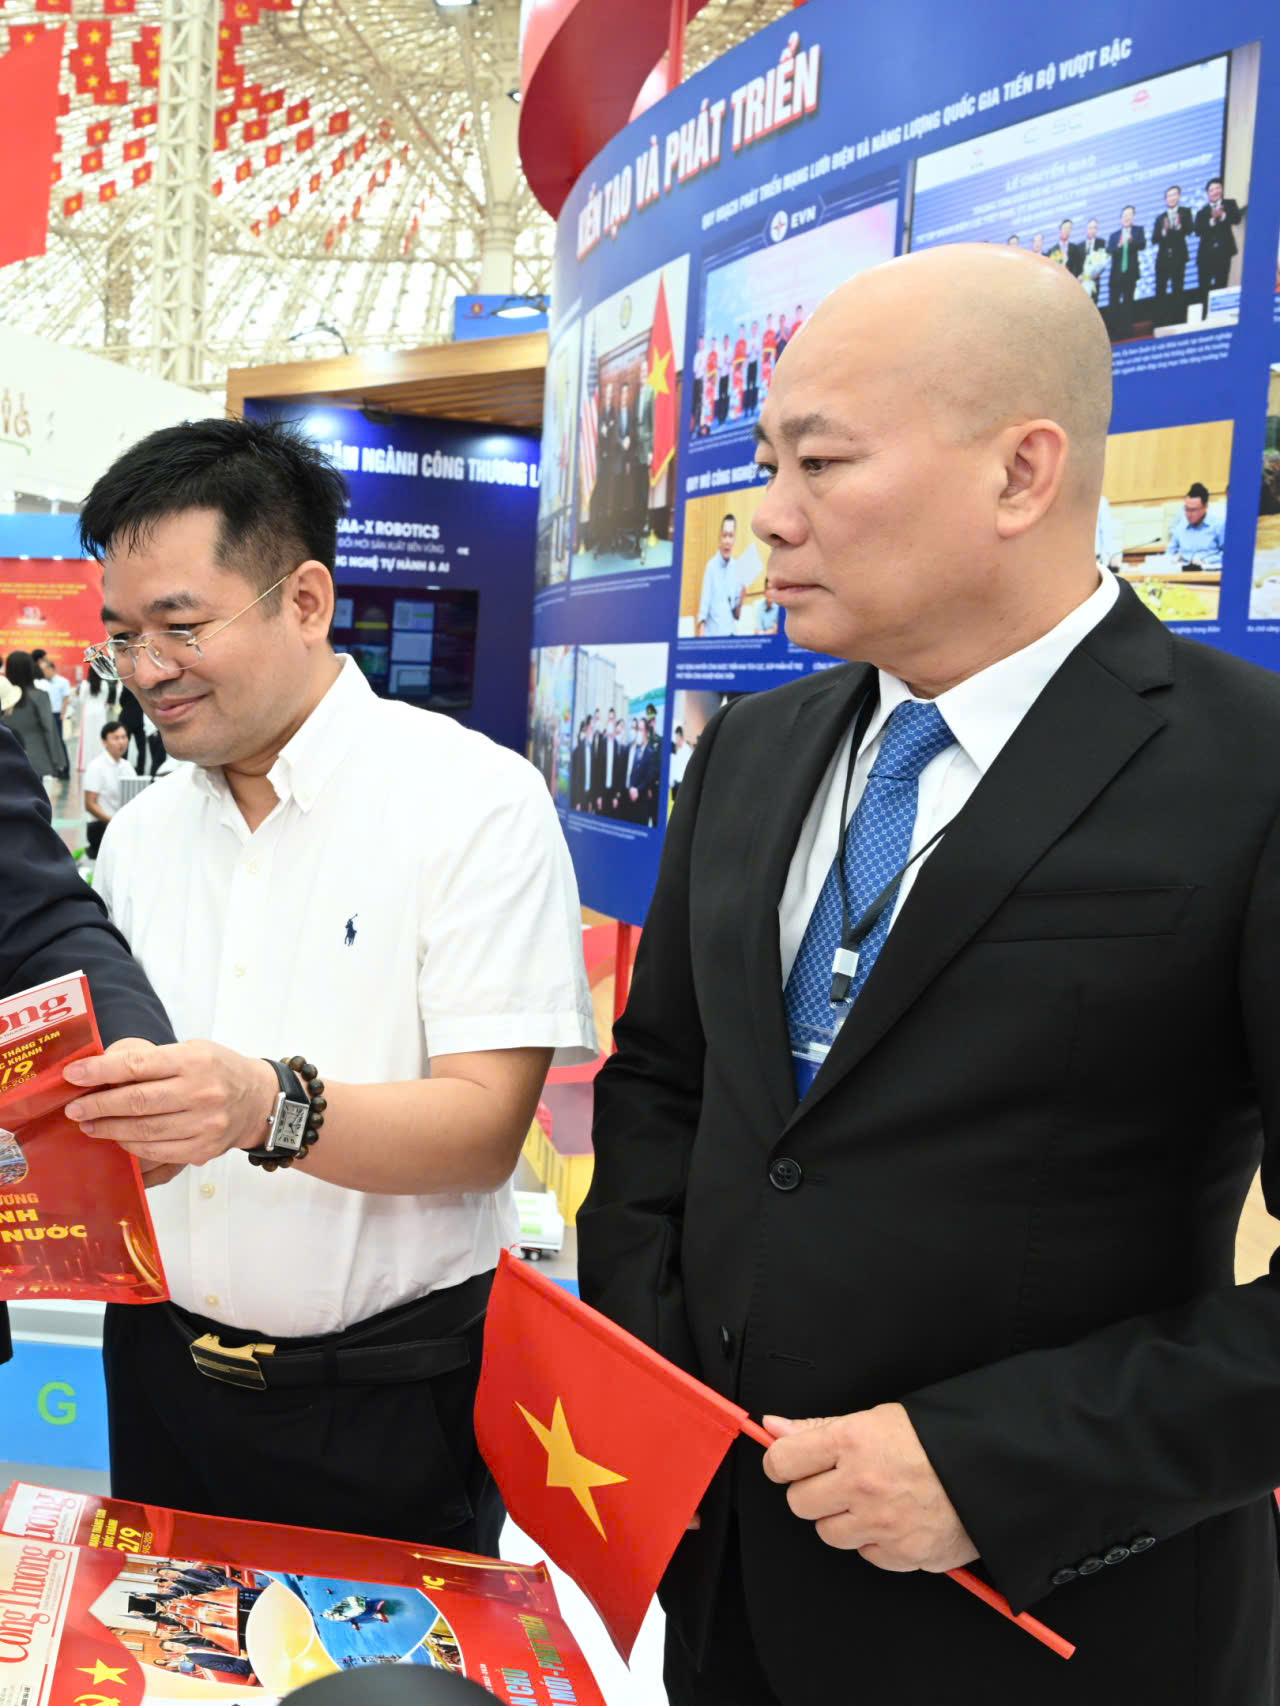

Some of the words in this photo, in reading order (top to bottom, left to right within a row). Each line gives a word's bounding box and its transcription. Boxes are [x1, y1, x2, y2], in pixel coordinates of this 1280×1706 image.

[856, 136, 870, 160] VÀ
[871, 126, 903, 154] NĂNG
[903, 110, 941, 141] LƯỢNG
[943, 92, 976, 126] QUỐC
[978, 87, 1000, 112] GIA
[1003, 71, 1034, 101] TIẾN
[1035, 62, 1056, 90] BỘ
[1059, 50, 1097, 81] VƯỢT
[1099, 38, 1132, 67] BẬC
[604, 165, 633, 239] TẠO
[636, 134, 660, 211] VÀ
[664, 98, 726, 192] PHÁT
[730, 31, 821, 151] TRIỂN
[790, 205, 817, 230] EVN
[361, 444, 418, 476] NGÀNH
[422, 450, 465, 480] CÔNG
[467, 458, 528, 487] THƯƠNG
[375, 520, 440, 540] ROBOTICS
[349, 555, 379, 572] NGHỆ
[380, 556, 396, 573] TỰ
[397, 557, 427, 573] HÀNH
[438, 562, 450, 573] AI
[3, 1041, 36, 1060] THÁNG
[38, 1031, 61, 1045] TÁM
[7, 1046, 42, 1065] KHÁNH
[0, 1223, 89, 1244] NƯỚC
[117, 1527, 143, 1553] 2/9
[528, 1640, 566, 1671] PHÁT
[495, 1667, 535, 1695] CHỦ
[539, 1674, 578, 1702] MỚI
